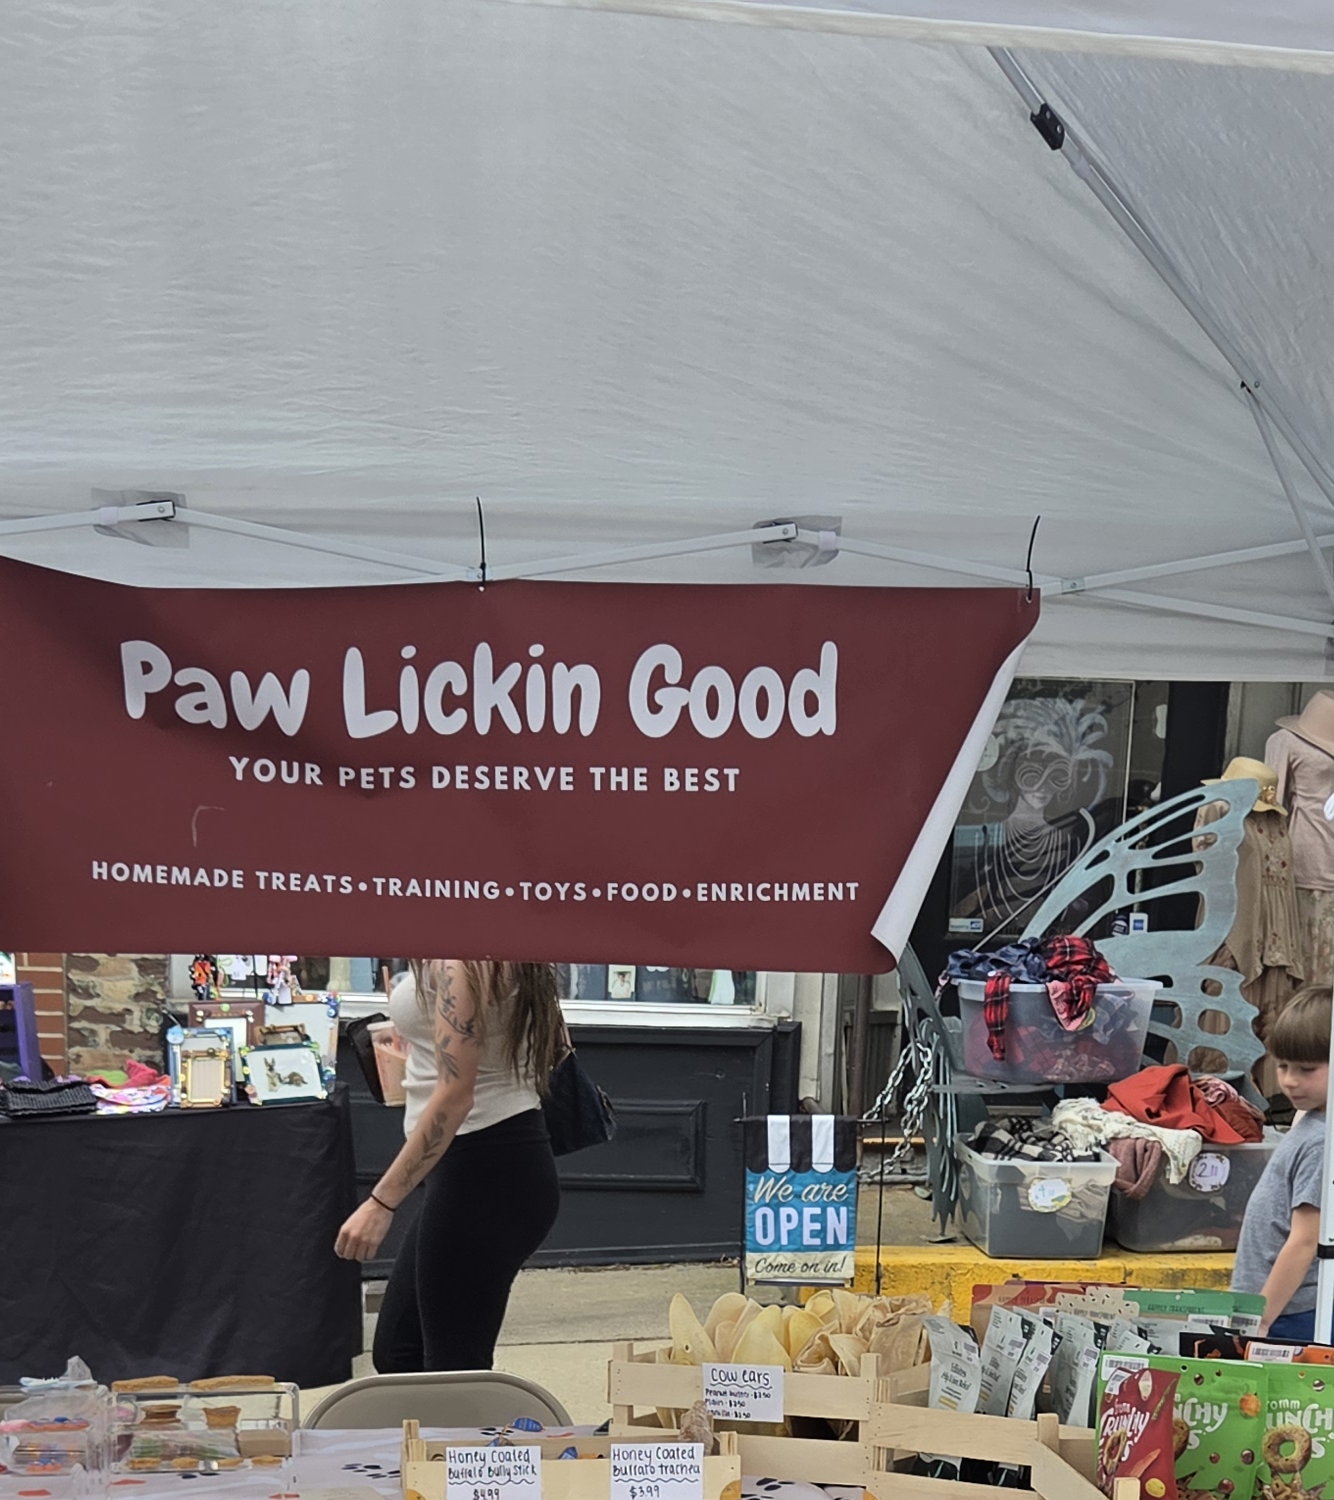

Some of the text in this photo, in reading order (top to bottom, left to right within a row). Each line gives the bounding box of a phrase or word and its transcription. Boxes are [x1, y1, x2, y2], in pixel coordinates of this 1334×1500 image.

[120, 639, 838, 739] Paw Lickin Good
[228, 756, 741, 793] YOUR PETS DESERVE THE BEST
[92, 860, 860, 902] HOMEMADE TREATS TRAINING TOYS FOOD ENRICHMENT
[755, 1176, 849, 1203] We are
[755, 1206, 848, 1246] OPEN
[755, 1256, 847, 1274] Come on in!
[448, 1447, 531, 1468] Honey Coated
[613, 1446, 695, 1466] Honey Coated
